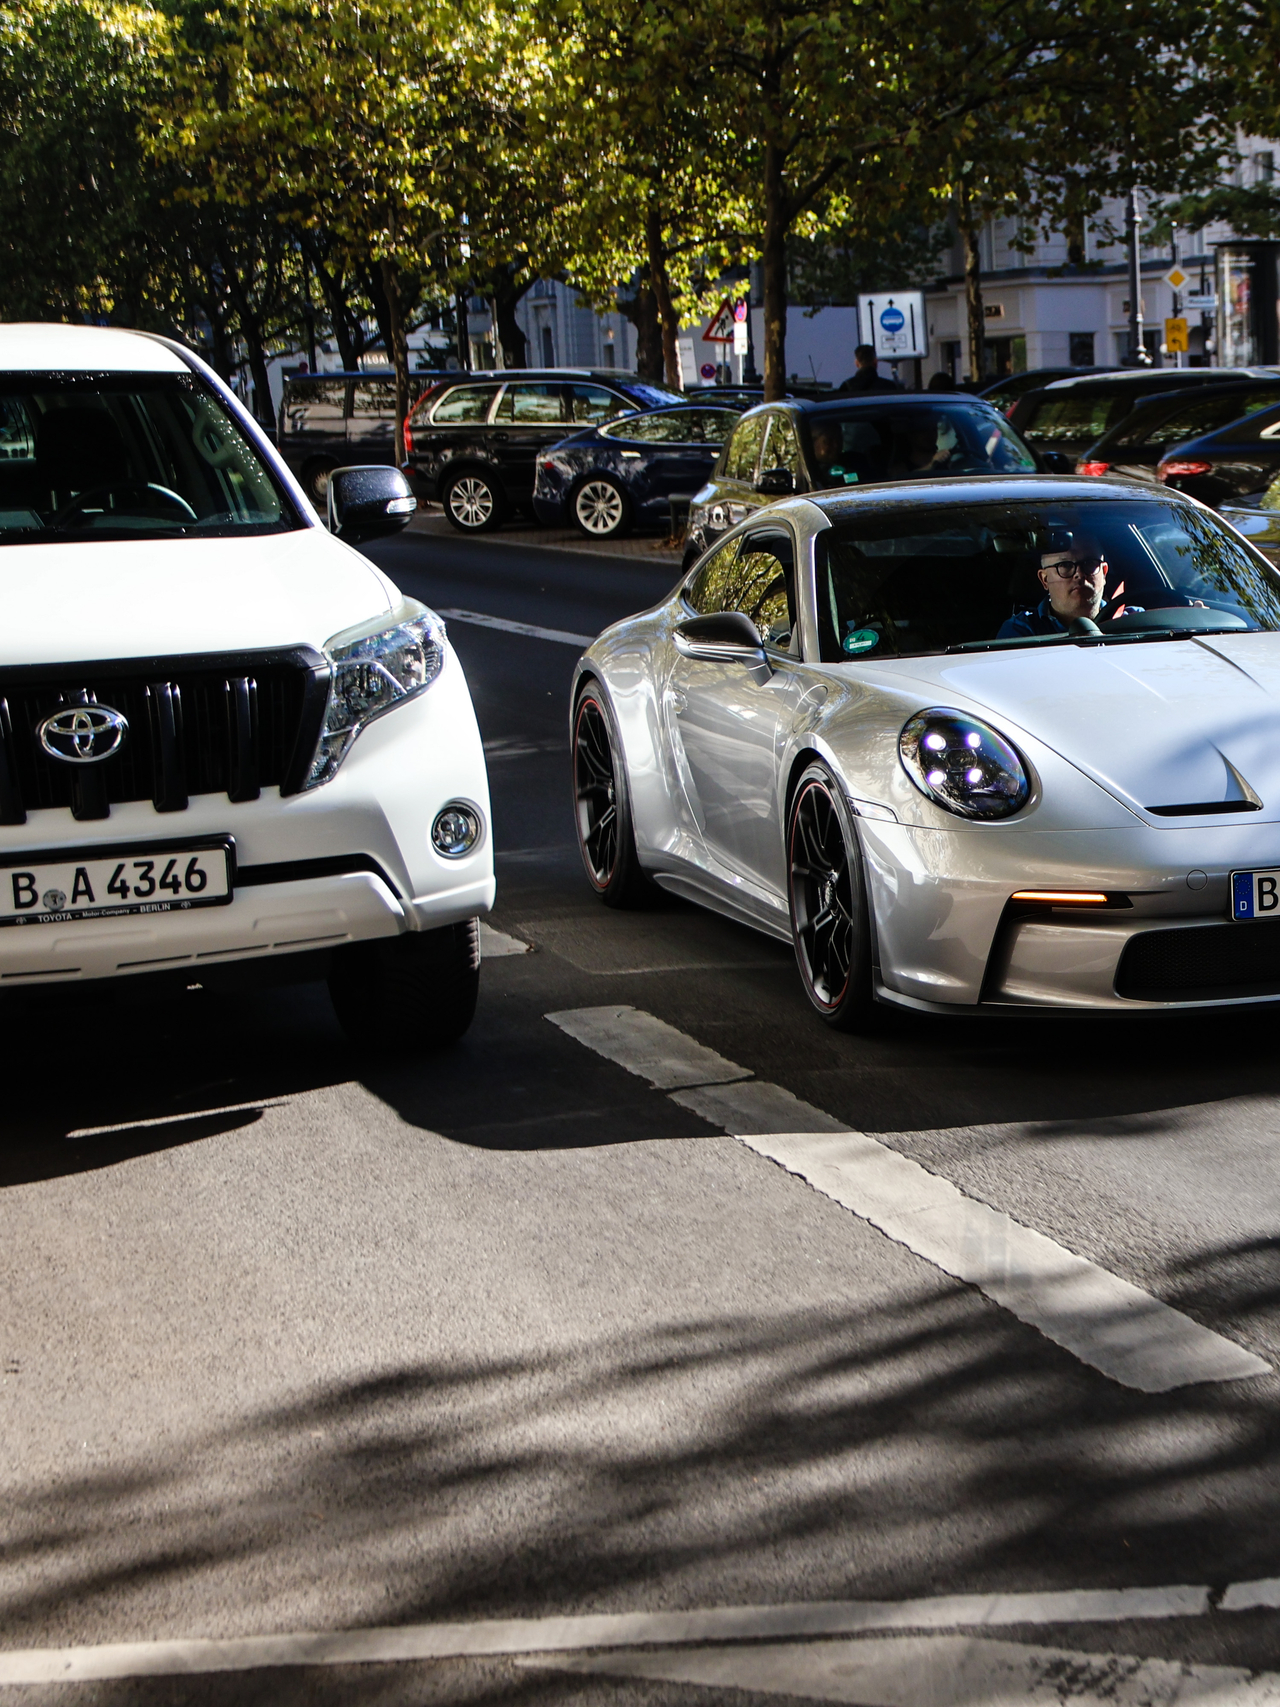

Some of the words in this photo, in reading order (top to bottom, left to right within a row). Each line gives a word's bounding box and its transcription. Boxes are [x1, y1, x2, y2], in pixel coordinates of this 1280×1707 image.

[11, 872, 39, 910] B
[71, 867, 96, 904] A
[107, 857, 207, 900] 4346
[1257, 877, 1279, 911] B
[38, 912, 73, 923] TOYOTA
[140, 902, 171, 913] BERLIN
[1240, 901, 1248, 911] D
